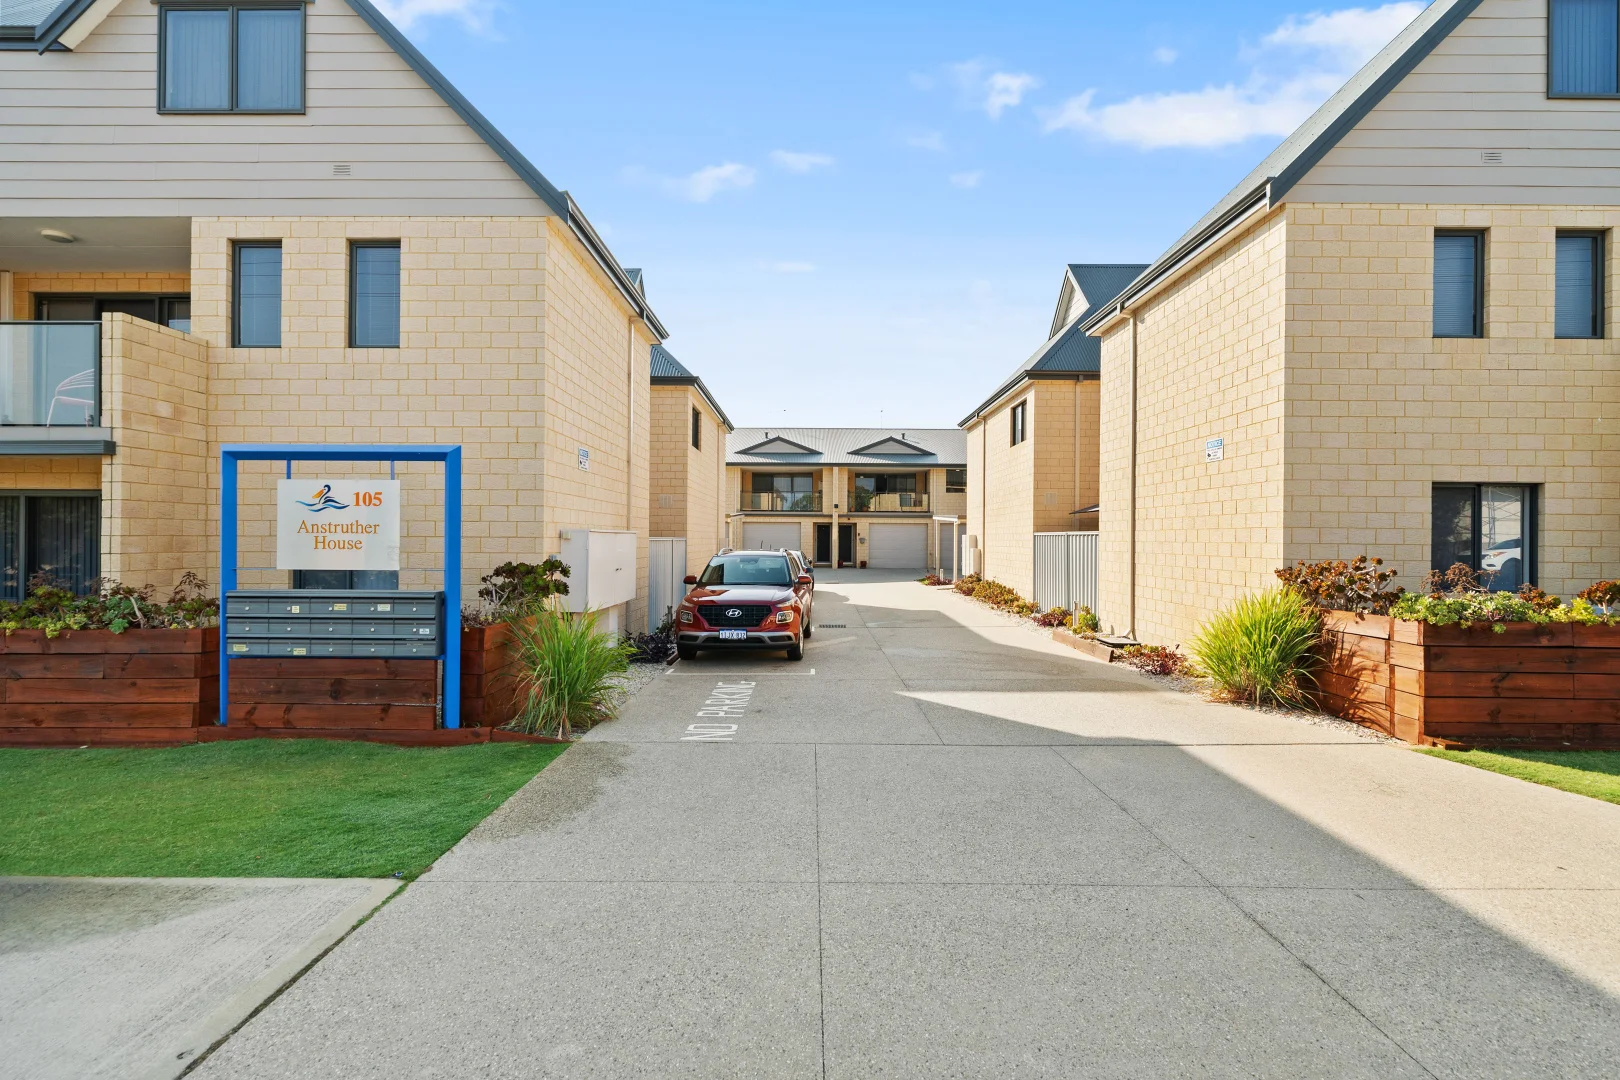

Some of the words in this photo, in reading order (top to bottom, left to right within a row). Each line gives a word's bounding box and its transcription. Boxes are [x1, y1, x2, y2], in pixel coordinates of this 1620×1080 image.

[353, 491, 383, 507] 105
[297, 519, 380, 535] Anstruther
[313, 535, 363, 551] House
[695, 681, 757, 717] PARKING
[680, 723, 738, 741] NO
